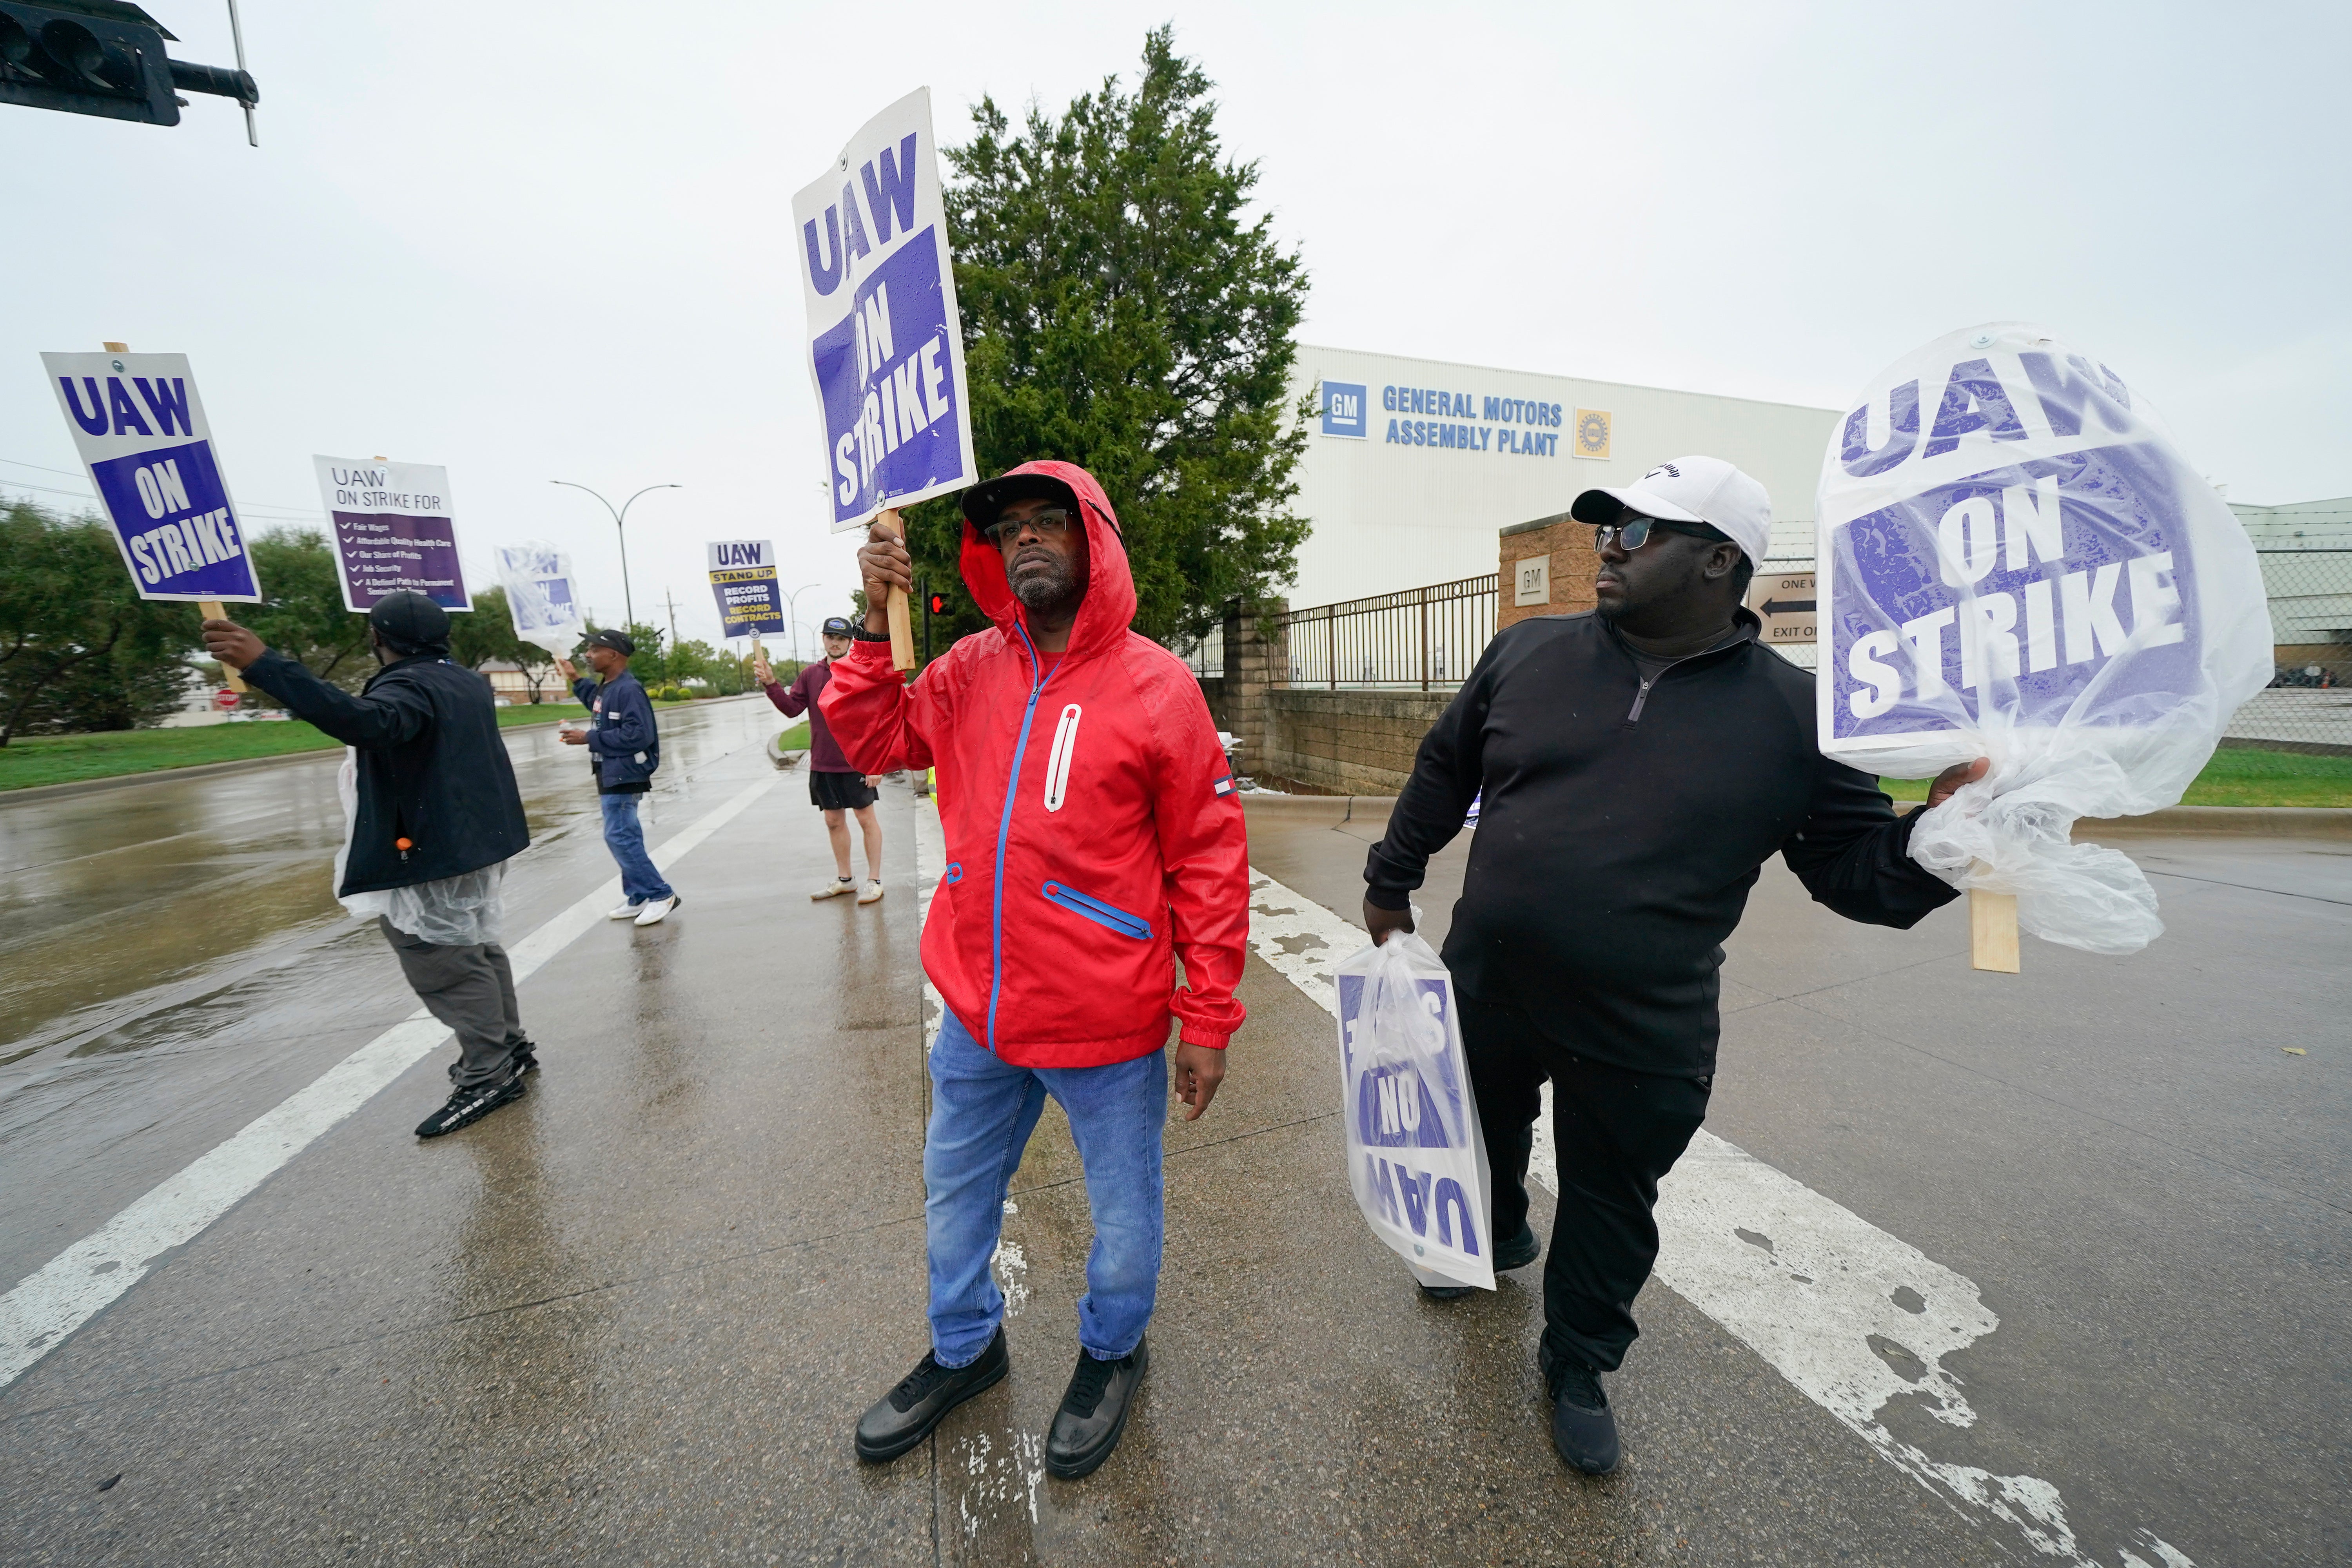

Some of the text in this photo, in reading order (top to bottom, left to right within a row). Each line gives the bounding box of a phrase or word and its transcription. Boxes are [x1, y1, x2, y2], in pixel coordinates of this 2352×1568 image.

[804, 132, 916, 296] UAW
[855, 280, 896, 393] ON
[59, 377, 192, 436] UAW
[1332, 393, 1357, 417] GM
[1383, 386, 1562, 427] GENERAL MOTORS
[1841, 352, 2131, 477] UAW
[835, 335, 949, 507] STRIKE
[1386, 419, 1558, 457] ASSEMBLY PLANT
[331, 468, 384, 487] UAW
[134, 459, 191, 519] ON
[337, 490, 441, 509] ON STRIKE FOR
[368, 524, 390, 533] Wages
[1938, 475, 2064, 588] ON
[130, 507, 242, 584] STRIKE
[356, 537, 390, 545] Affordable
[390, 537, 414, 547] Quality
[400, 551, 423, 560] Profits
[717, 543, 760, 565] UAW
[397, 577, 412, 586] Path
[714, 570, 773, 582] STAND UP
[1524, 568, 1541, 589] GM
[1782, 580, 1806, 589] ONE
[724, 585, 768, 596] RECORD
[726, 594, 770, 605] PROFITS
[725, 612, 781, 624] CONTRACTS
[729, 604, 771, 615] RECORD
[1773, 627, 1800, 637] EXIT
[1848, 551, 2184, 720] STRIKE
[1378, 1071, 1421, 1135] ON
[1366, 1153, 1480, 1256] UAW
